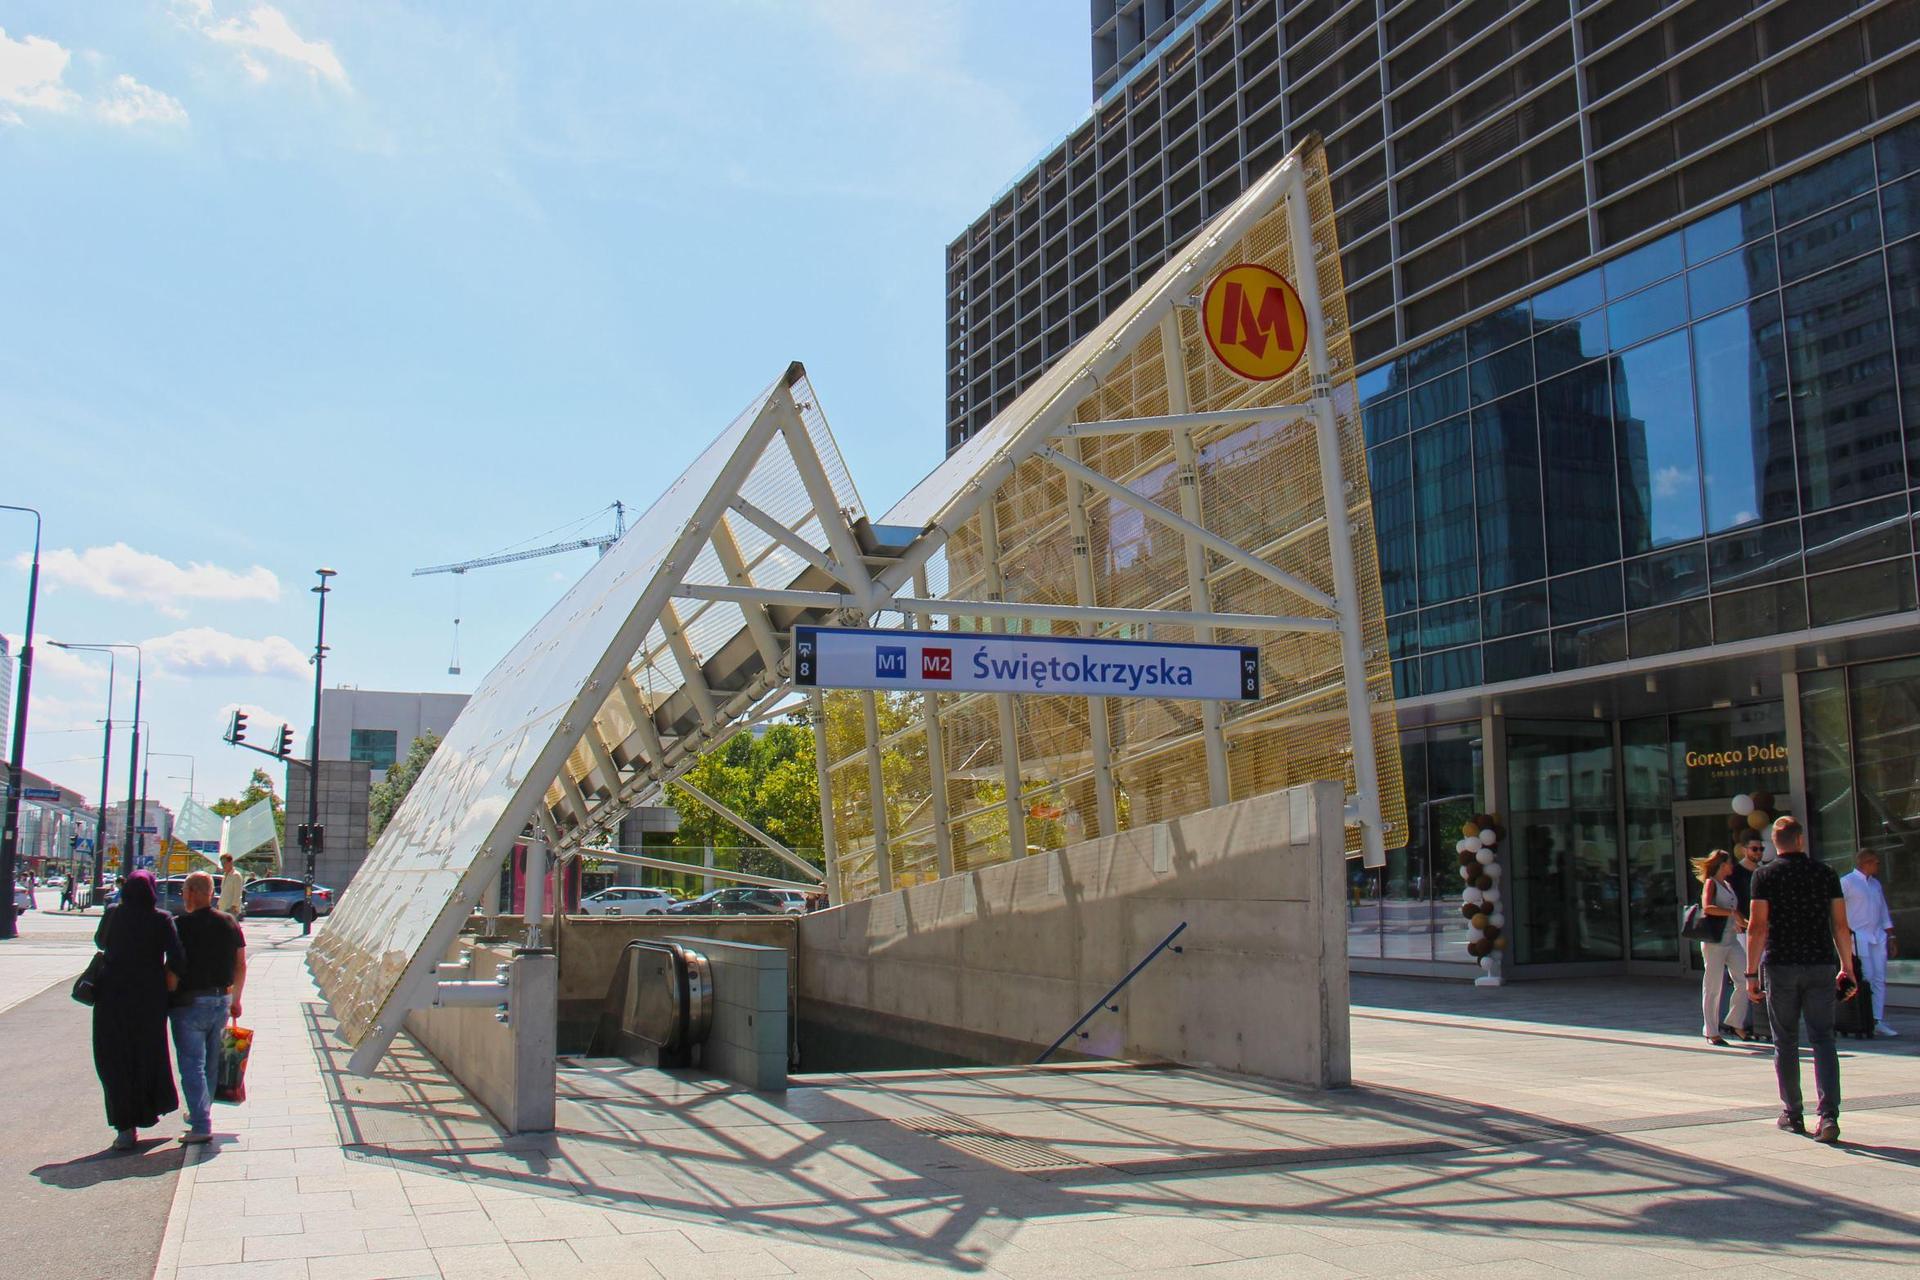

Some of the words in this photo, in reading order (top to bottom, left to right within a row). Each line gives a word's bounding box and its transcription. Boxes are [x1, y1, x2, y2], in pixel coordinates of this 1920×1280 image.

[1220, 282, 1294, 360] M
[800, 662, 809, 676] 8
[878, 654, 905, 670] M1
[923, 655, 951, 672] M2
[973, 645, 1193, 691] Świętokrzyska
[1247, 678, 1255, 691] 8
[1686, 751, 1743, 767] Gorąco
